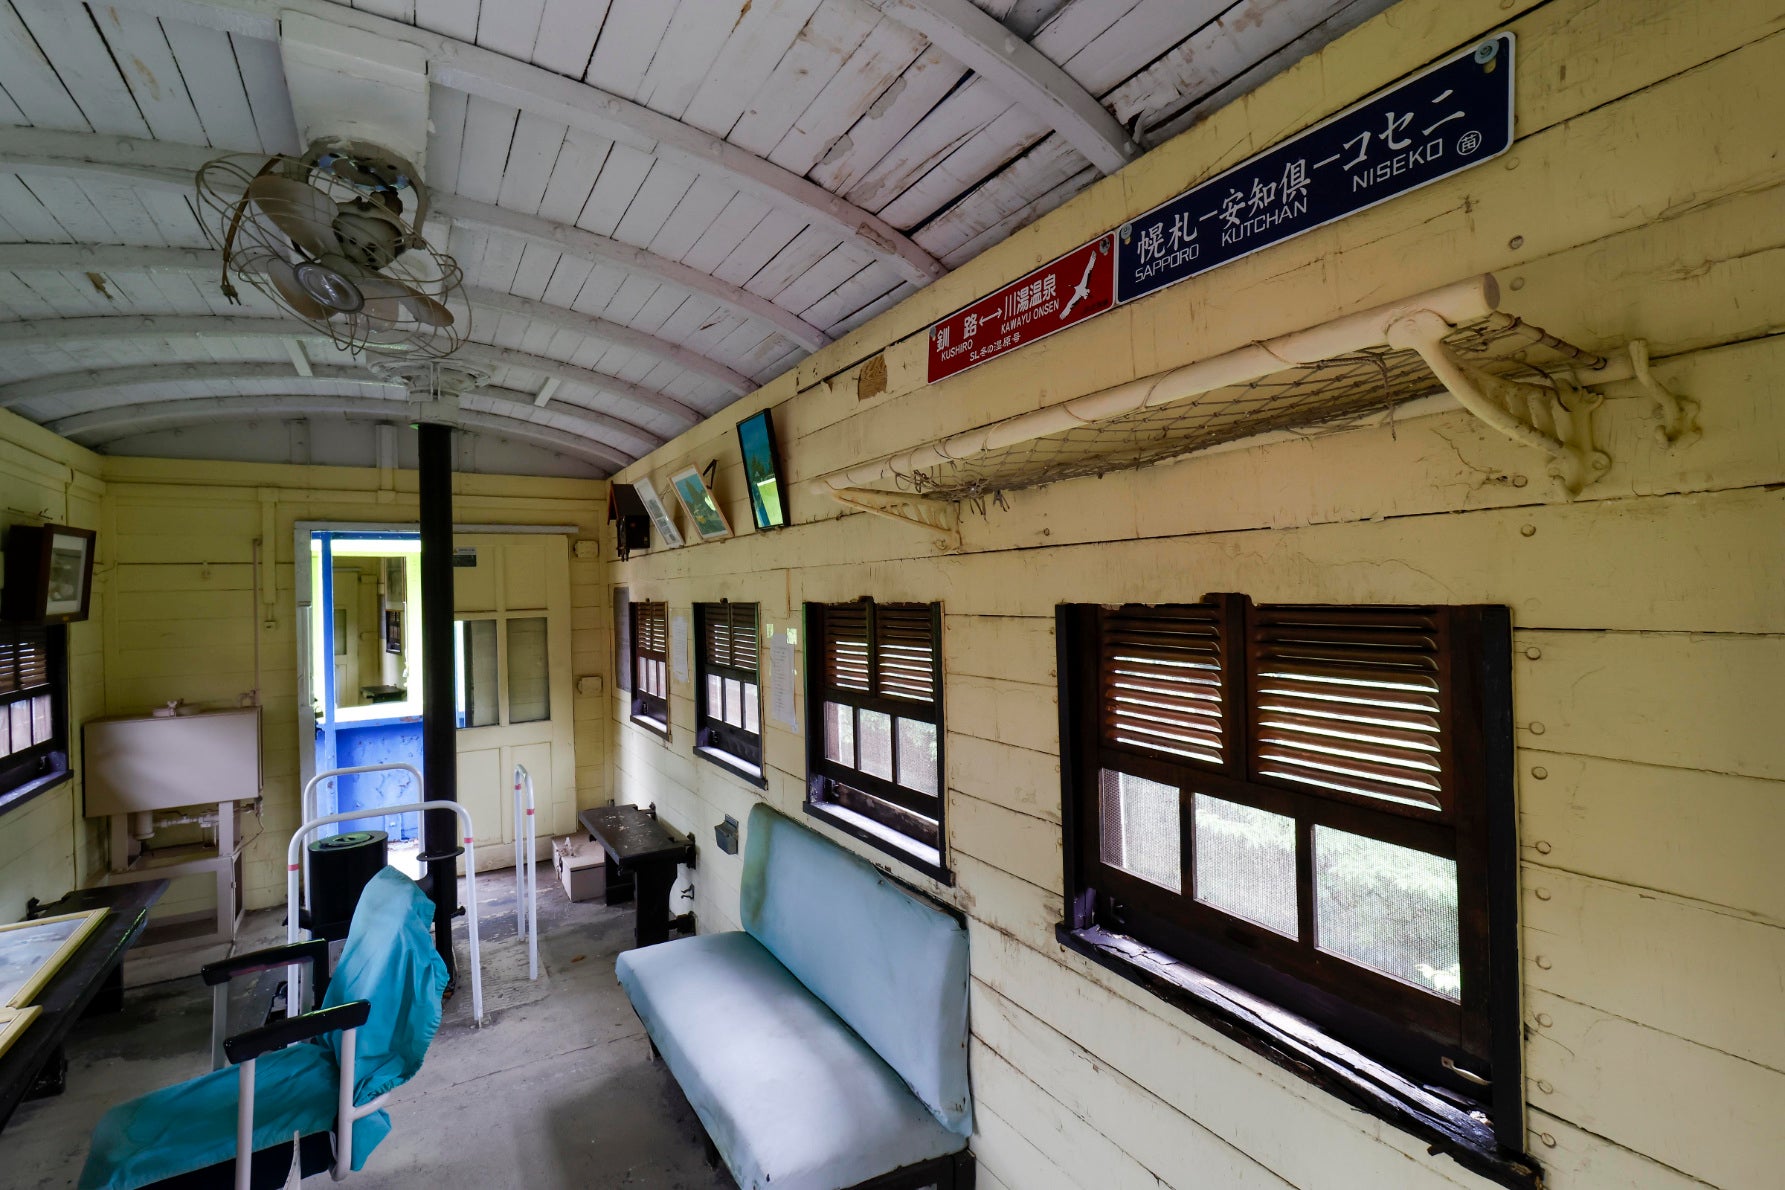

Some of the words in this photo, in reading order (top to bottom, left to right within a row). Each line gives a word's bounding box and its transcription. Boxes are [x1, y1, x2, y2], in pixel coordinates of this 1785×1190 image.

[1135, 243, 1199, 283] SAPPORO
[1221, 196, 1308, 247] KUTCHAN
[1352, 139, 1444, 193] NISEKO
[1003, 273, 1057, 321] 川湯温泉
[941, 338, 974, 362] KUSHIRO
[1001, 312, 1032, 335] KAWAYU
[1033, 298, 1060, 321] ONSEN
